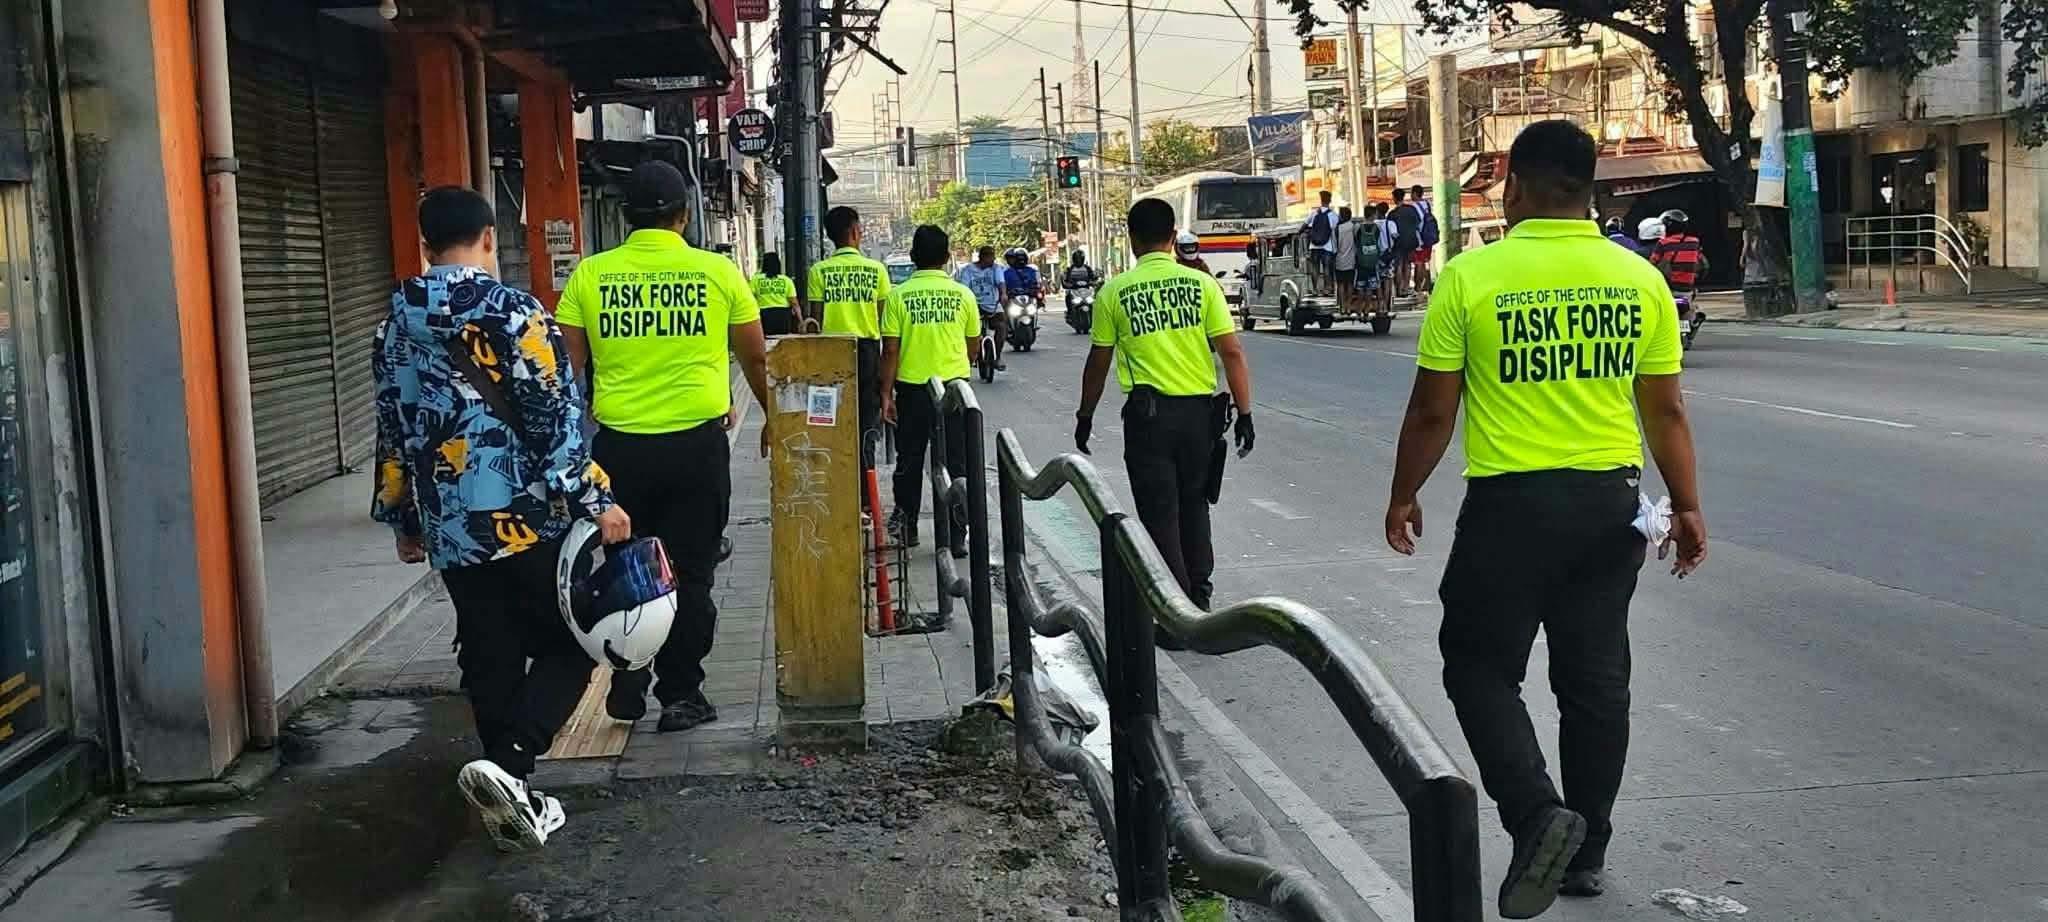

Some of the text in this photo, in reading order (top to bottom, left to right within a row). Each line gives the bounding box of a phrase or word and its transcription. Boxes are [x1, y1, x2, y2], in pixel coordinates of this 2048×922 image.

[736, 113, 765, 126] VAPE
[739, 138, 767, 151] SHOP
[600, 271, 706, 282] OFFICE OF THE CITY MAYOR
[823, 273, 878, 289] TASK FORCE
[1149, 281, 1161, 289] THE
[1162, 279, 1177, 288] CITY
[600, 283, 708, 309] TASK FORCE
[825, 287, 873, 303] DISIPLINA
[1120, 286, 1202, 318] TASK FORCE
[1496, 287, 1640, 308] OFFICE OF THE CITY MAYOR
[904, 297, 961, 312] TASK FORCE
[600, 310, 706, 338] DISIPLINA
[911, 310, 956, 324] DISIPLINA
[1497, 304, 1641, 344] TASK FORCE
[1500, 342, 1634, 383] DISIPLINA
